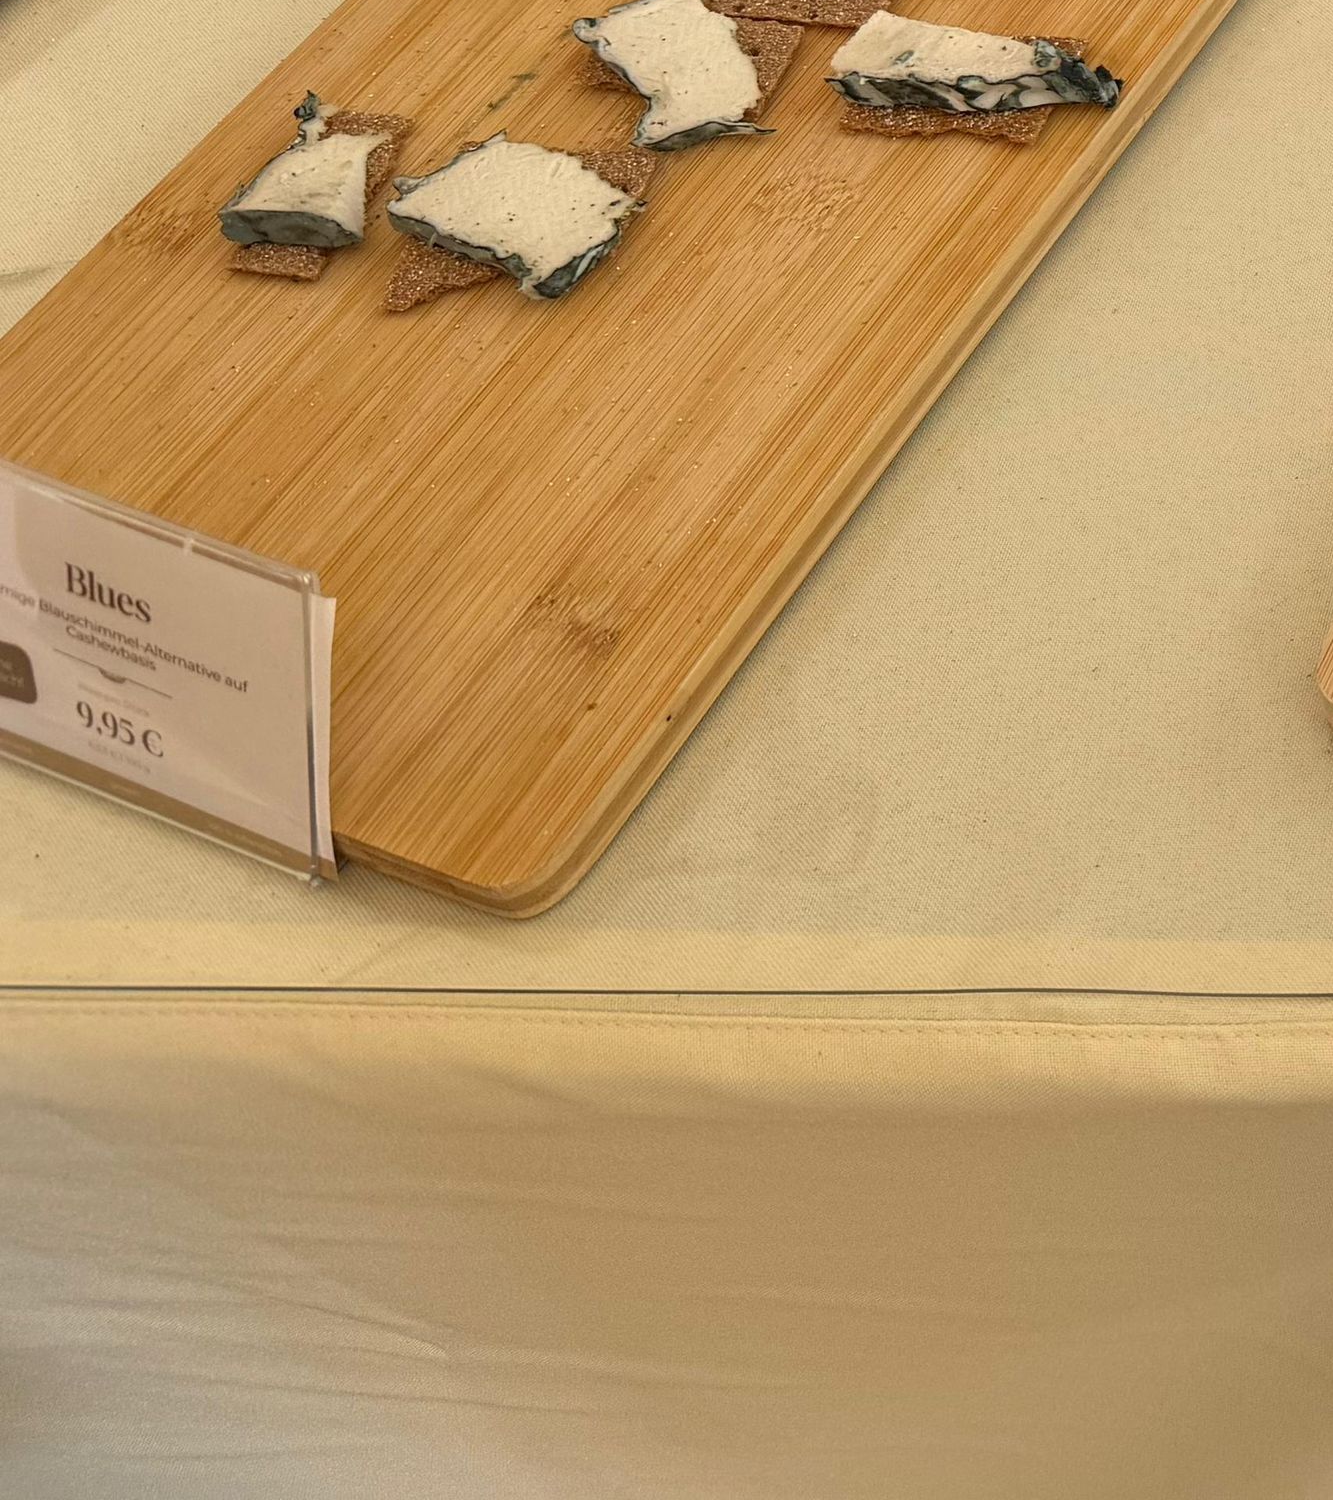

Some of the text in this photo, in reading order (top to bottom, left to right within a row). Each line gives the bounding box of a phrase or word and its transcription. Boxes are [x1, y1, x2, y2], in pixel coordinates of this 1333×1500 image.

[65, 562, 152, 623] Blues
[39, 598, 221, 683] Blauschimmel-Alternative
[225, 676, 248, 693] auf
[66, 625, 156, 671] Cashewbasis
